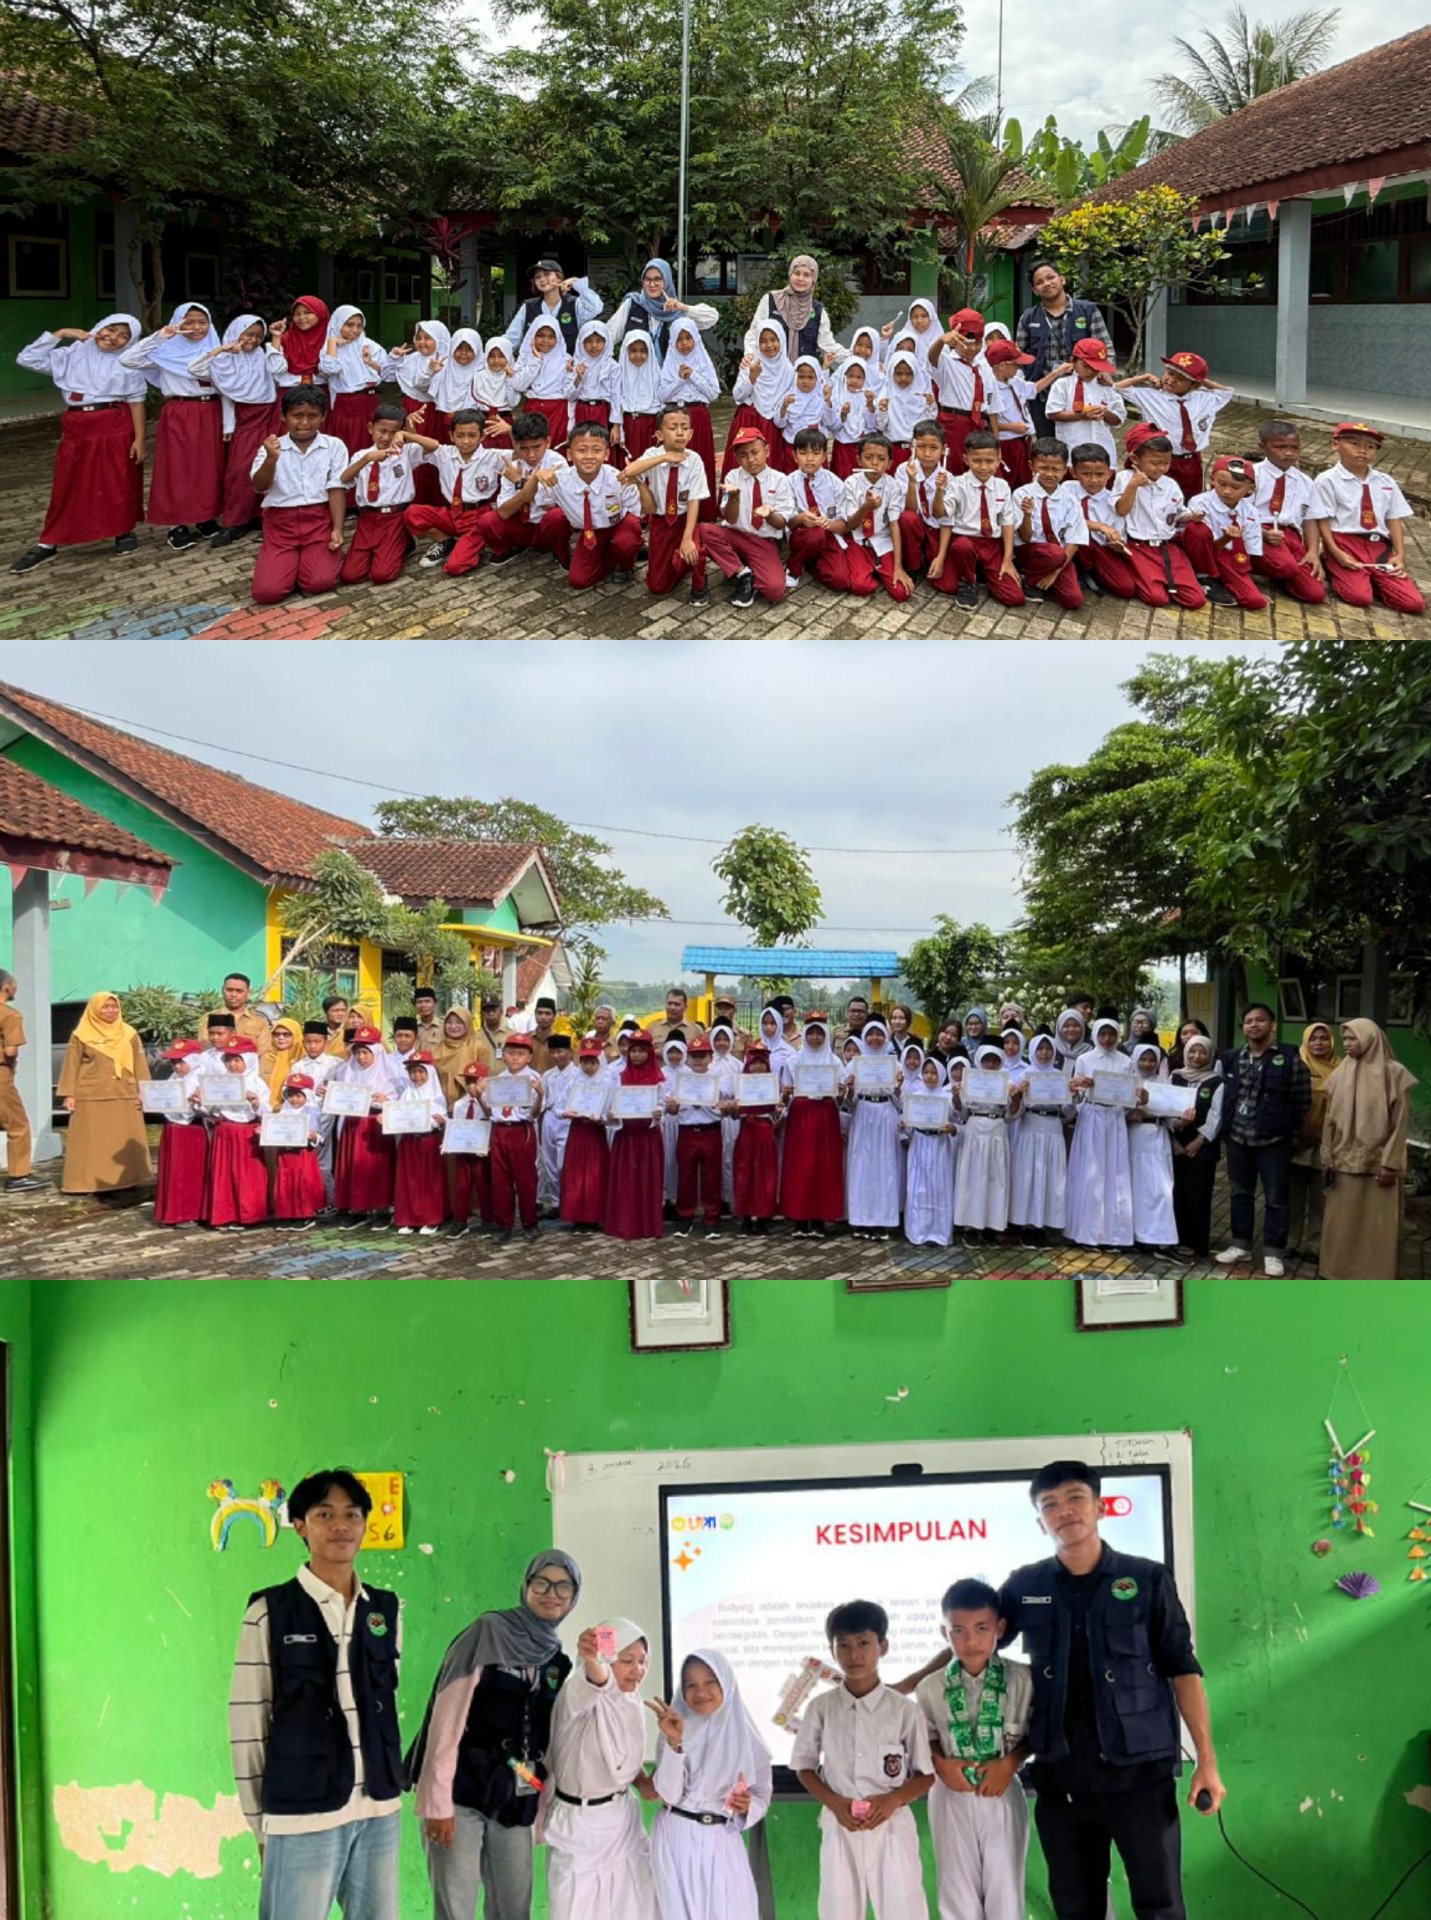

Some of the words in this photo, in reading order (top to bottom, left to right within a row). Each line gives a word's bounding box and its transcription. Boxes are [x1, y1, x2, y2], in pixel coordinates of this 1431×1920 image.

[657, 1457, 692, 1471] 2026
[816, 1519, 988, 1545] KESIMPULAN
[759, 1601, 790, 1611] adalah
[795, 1600, 834, 1609] tindakan
